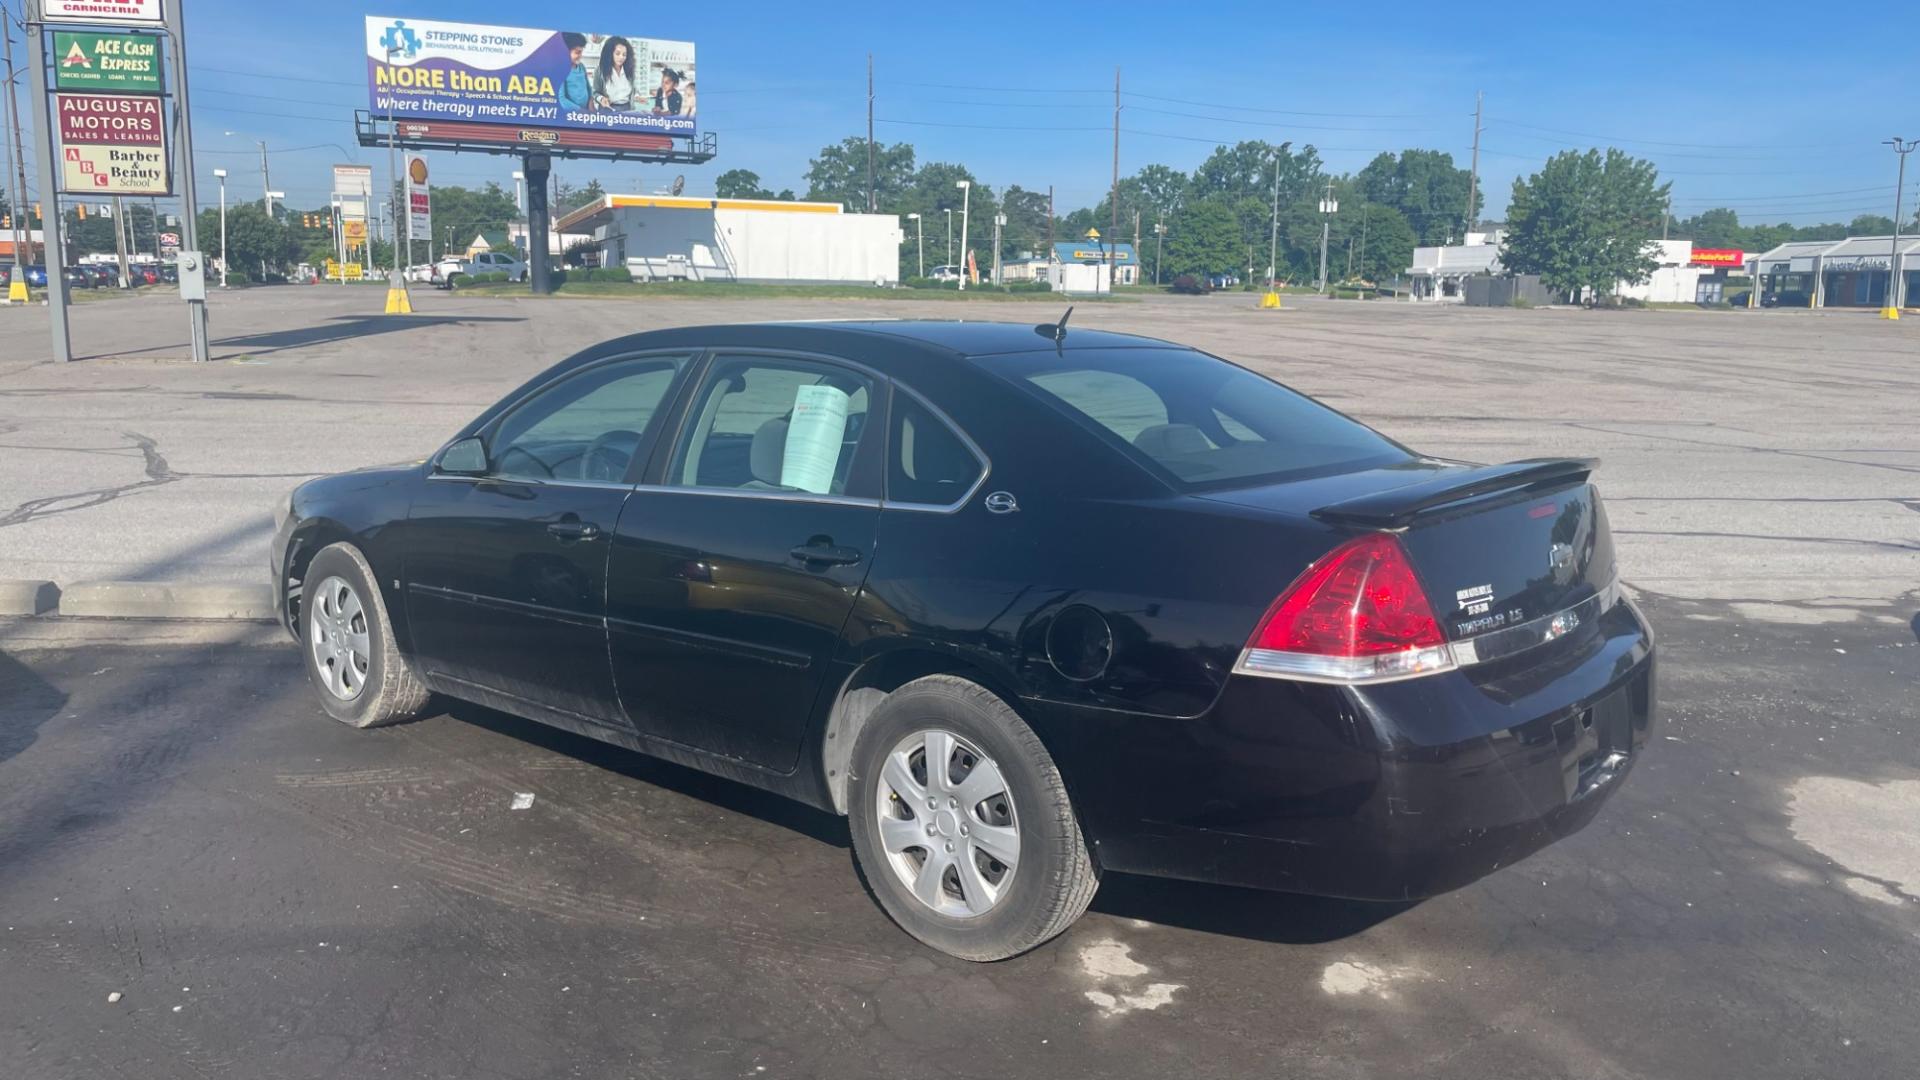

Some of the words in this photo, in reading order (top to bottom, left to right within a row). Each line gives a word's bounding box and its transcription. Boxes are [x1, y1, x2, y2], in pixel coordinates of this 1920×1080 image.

[63, 4, 140, 14] CARNICERIA
[425, 31, 478, 43] STEPPING
[481, 35, 523, 47] STONES
[94, 39, 120, 54] ACE
[124, 41, 154, 56] CASH
[100, 55, 150, 72] EXPRESS
[376, 66, 445, 89] MORE
[450, 70, 501, 92] than
[507, 75, 555, 96] ABA
[436, 90, 460, 99] Therapy
[63, 98, 157, 114] AUGUSTA
[376, 96, 420, 111] Where
[422, 98, 475, 118] therapy
[477, 104, 517, 117] meets
[520, 105, 558, 119] PLAY!
[70, 115, 153, 131] MOTORS
[566, 111, 694, 129] steppingstonesindy.com
[64, 131, 99, 139] SALES
[114, 132, 160, 141] LEASING
[67, 149, 79, 160] A
[109, 150, 160, 162] Barber
[81, 162, 92, 173] B
[131, 161, 141, 170] &
[111, 166, 161, 181] Beauty
[95, 175, 107, 186] C
[120, 177, 151, 188] School
